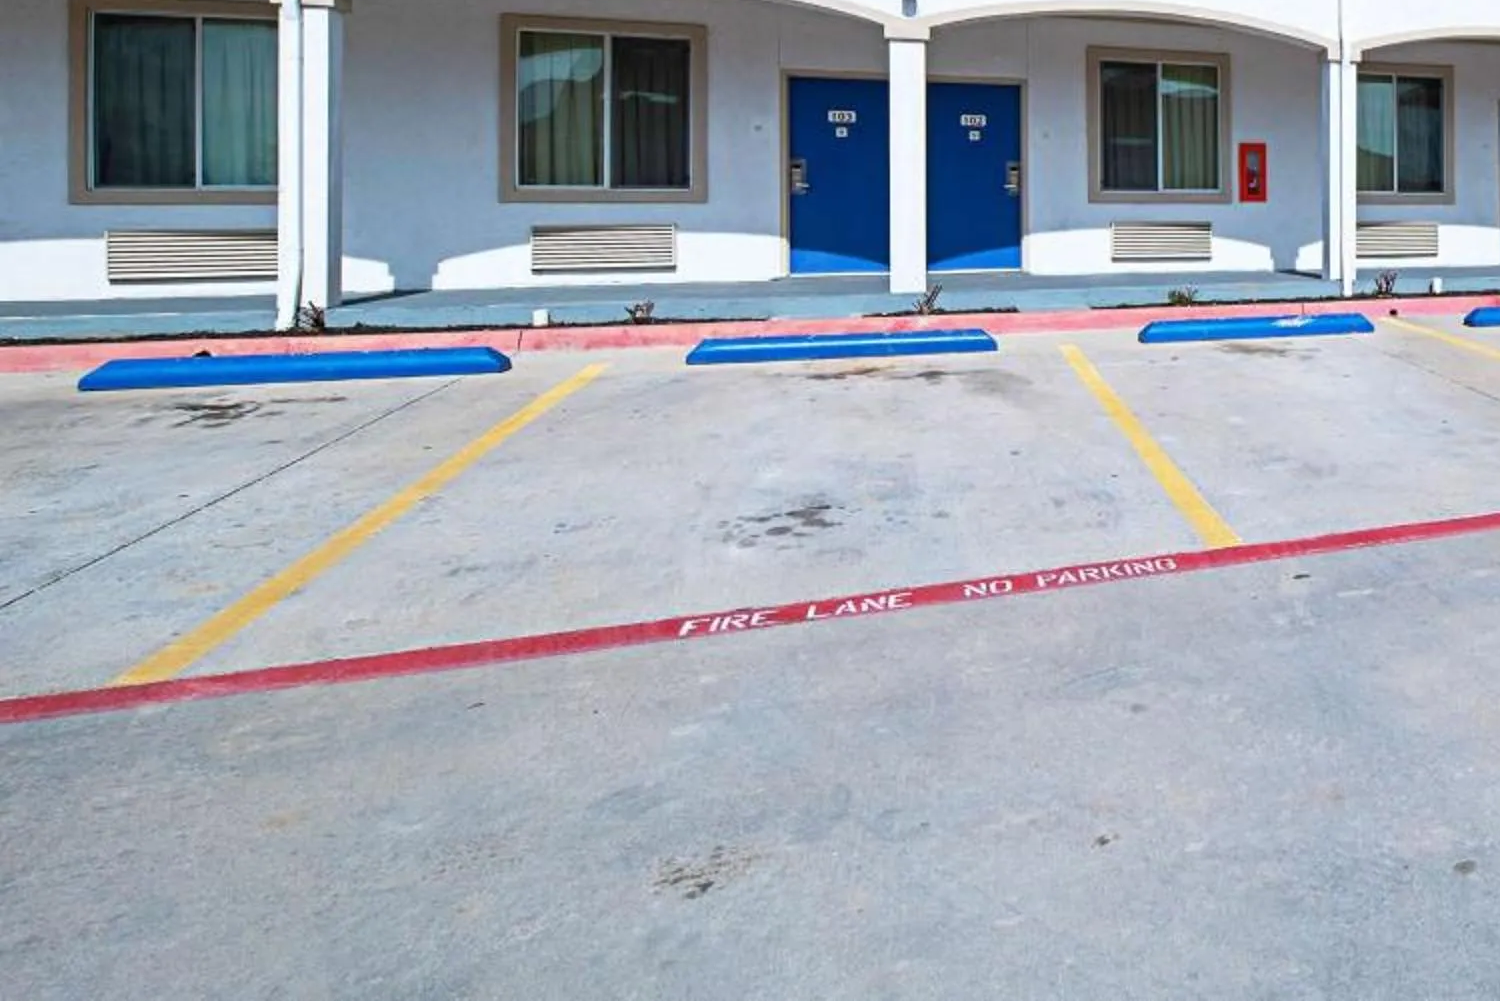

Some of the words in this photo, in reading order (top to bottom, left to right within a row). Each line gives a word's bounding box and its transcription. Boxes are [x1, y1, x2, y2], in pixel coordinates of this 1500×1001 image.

[679, 610, 779, 636] FIRE
[805, 592, 913, 619] LANE
[962, 580, 1013, 597] NO
[1036, 558, 1177, 588] PARKING
